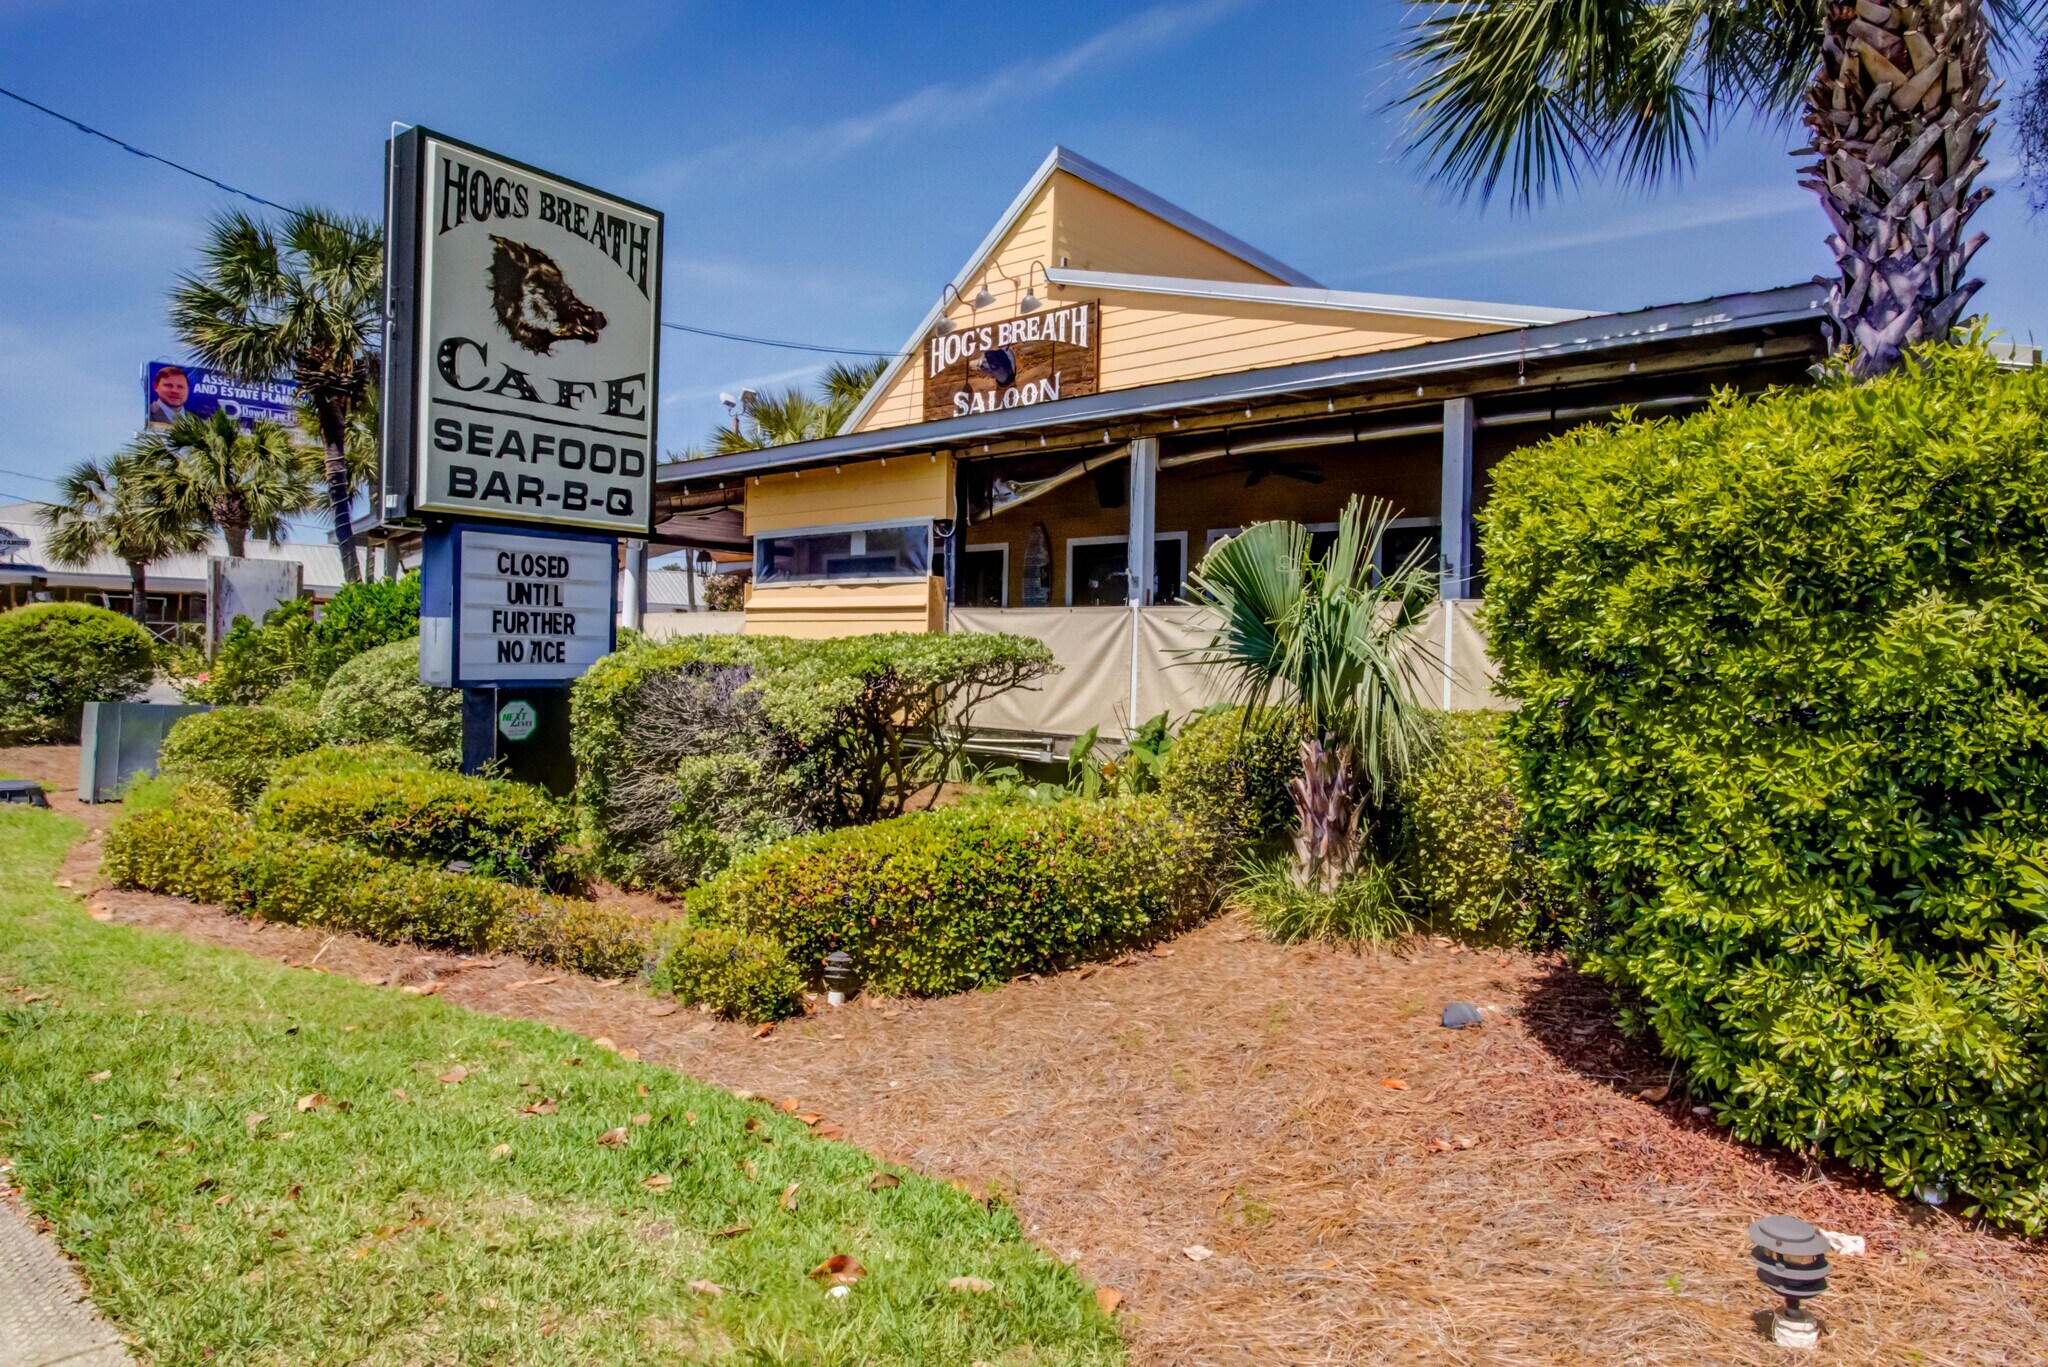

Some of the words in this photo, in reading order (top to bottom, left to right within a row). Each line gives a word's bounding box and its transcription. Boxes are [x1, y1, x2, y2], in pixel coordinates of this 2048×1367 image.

[438, 157, 529, 236] HOG'S
[538, 190, 651, 300] BREATH
[930, 326, 992, 378] HOG'S
[998, 304, 1089, 348] BREATH
[193, 383, 218, 395] AND
[220, 387, 259, 401] ESTATE
[436, 337, 647, 421] CAFE
[953, 371, 1061, 417] SALOON
[434, 417, 646, 478] SEAFOOD
[448, 465, 635, 517] BAR-B-Q
[497, 551, 569, 578] CLOSED
[506, 582, 564, 607] UNTIL
[492, 610, 576, 635] FURTHER
